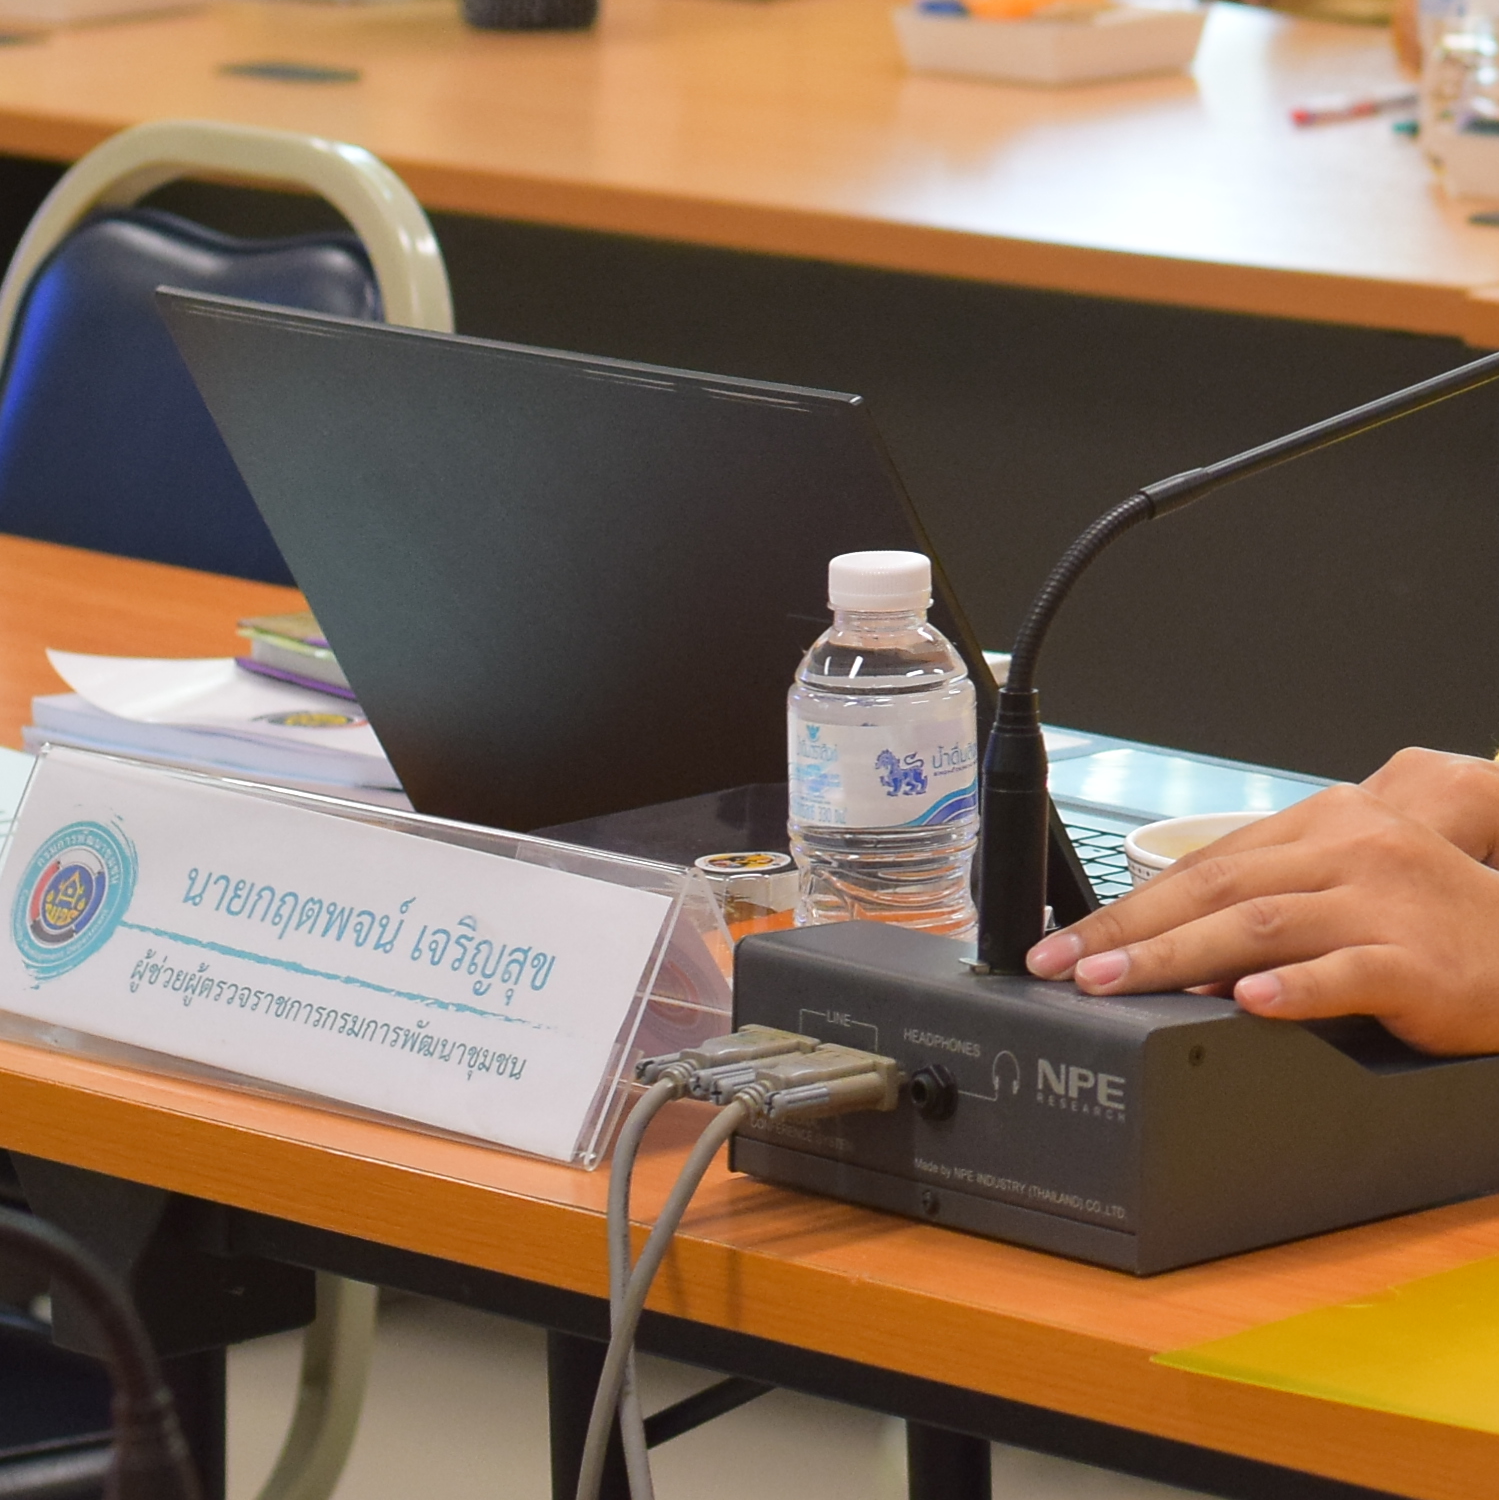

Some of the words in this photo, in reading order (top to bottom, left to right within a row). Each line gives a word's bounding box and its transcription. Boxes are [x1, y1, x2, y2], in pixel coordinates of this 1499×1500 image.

[181, 866, 417, 955] นายกฤตพจน์
[410, 914, 557, 1006] เจริญสุข
[128, 948, 527, 1081] ผู้ช่วยผู้ตรวจราชการกรมการพัฒนาชุมชน
[826, 1010, 852, 1027] LINE
[903, 1027, 982, 1058] HEADPHONES
[1037, 1058, 1126, 1111] NPE
[1036, 1091, 1126, 1124] RESEARCH
[914, 1157, 939, 1174] Made
[940, 1164, 952, 1179] by
[953, 1166, 975, 1183] NPE
[976, 1172, 1027, 1194] INDUSTRY
